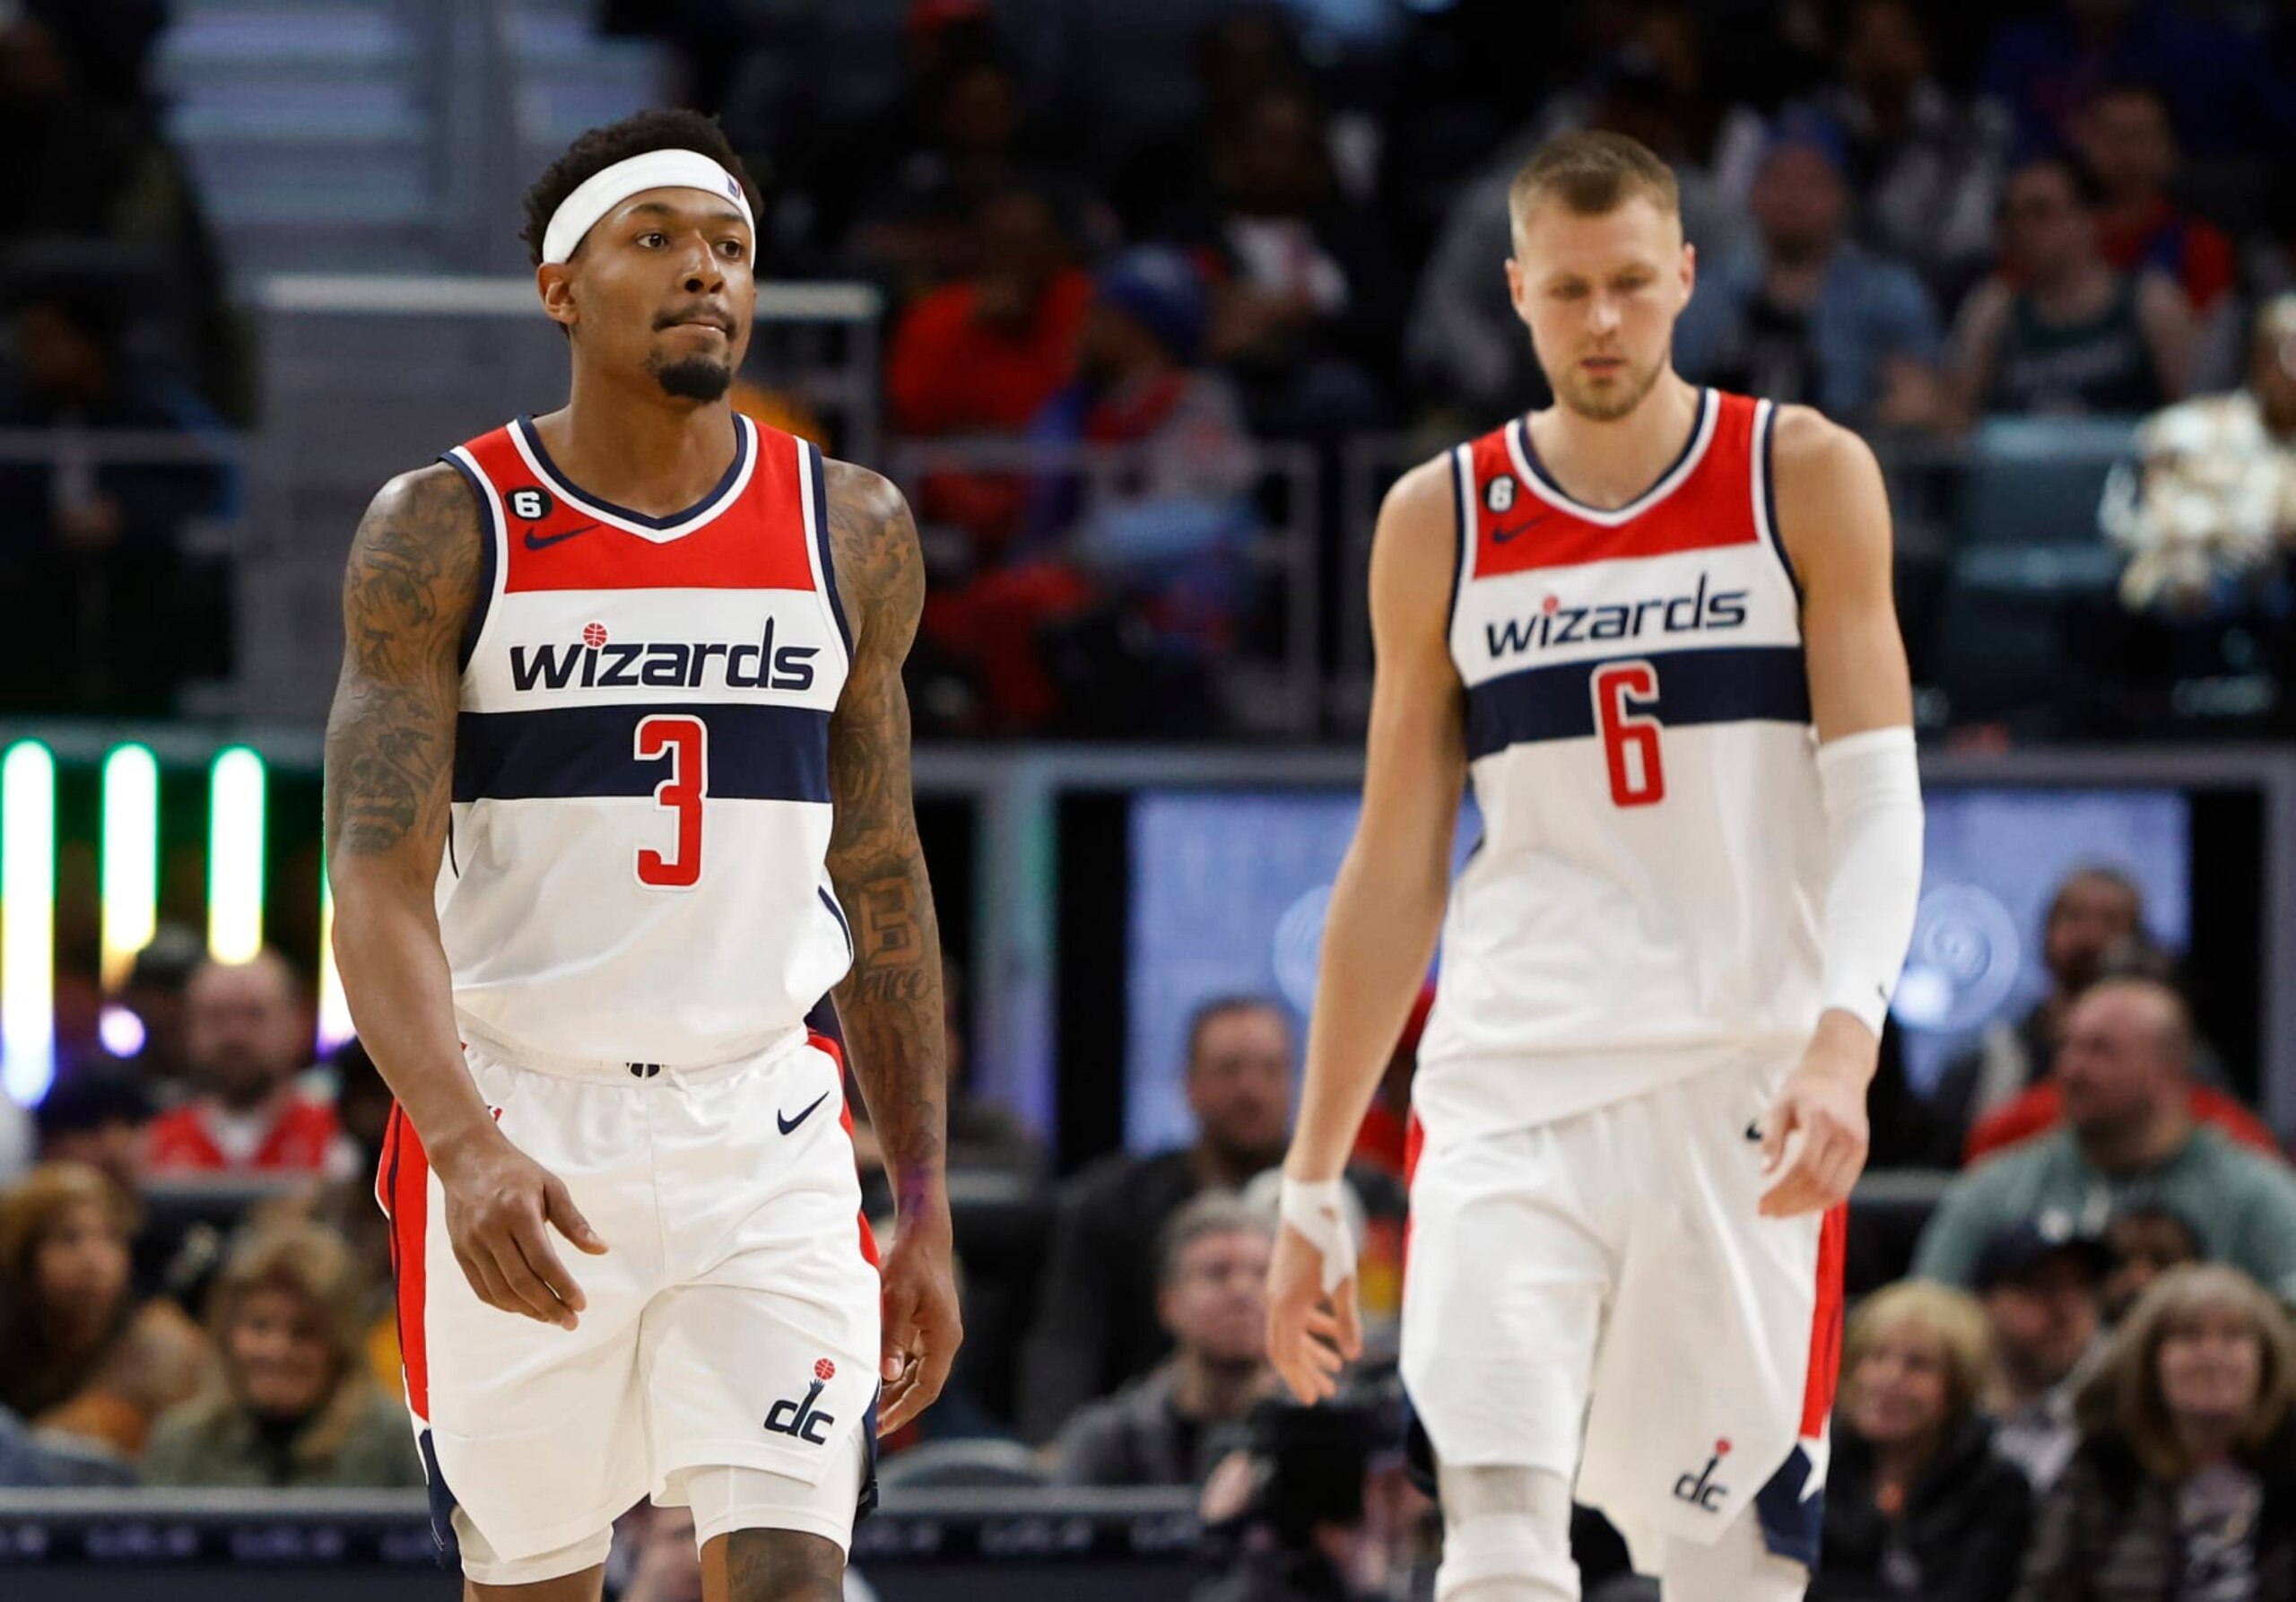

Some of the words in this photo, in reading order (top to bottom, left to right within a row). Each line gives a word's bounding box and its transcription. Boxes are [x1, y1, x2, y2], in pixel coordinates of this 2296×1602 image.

[513, 491, 543, 518] 6
[1489, 475, 1514, 511] 6
[1485, 571, 1749, 658] wizards
[509, 615, 821, 692] wizards
[1594, 662, 1666, 809] 6
[635, 715, 707, 889] 3
[764, 1379, 835, 1446] dc
[1673, 1454, 1726, 1513] dc
